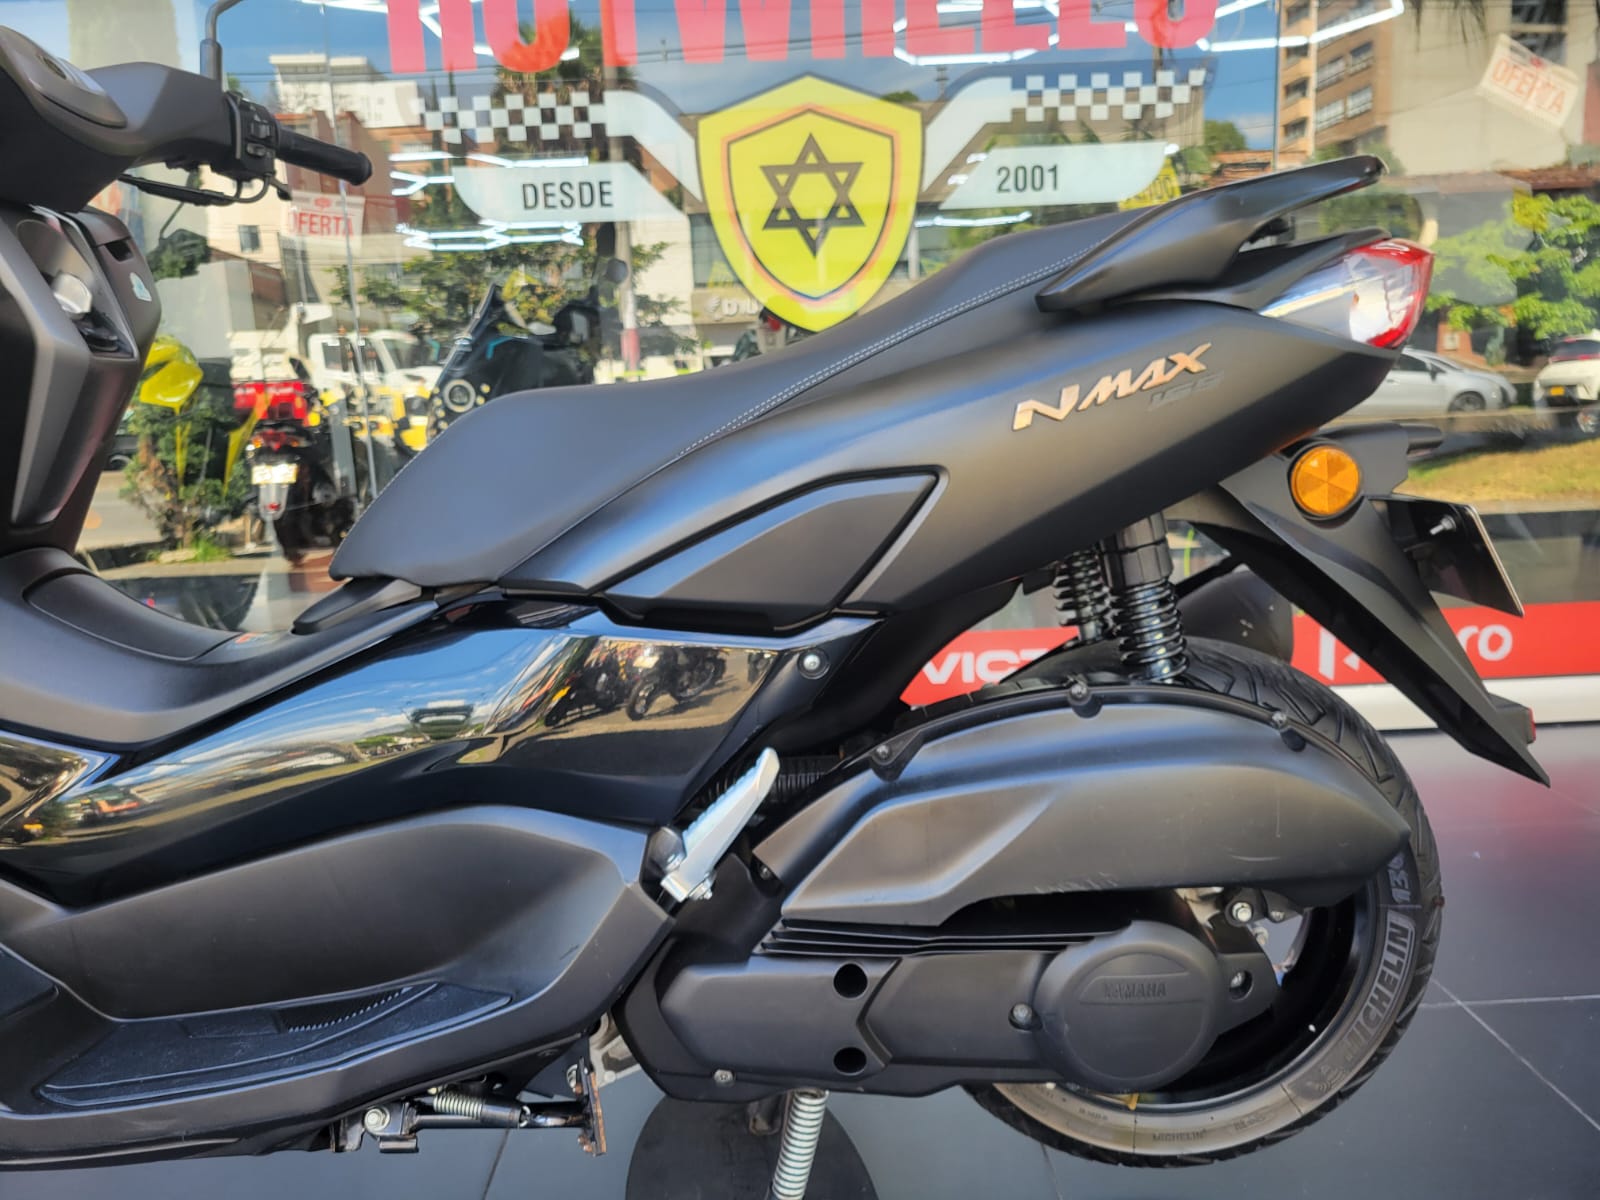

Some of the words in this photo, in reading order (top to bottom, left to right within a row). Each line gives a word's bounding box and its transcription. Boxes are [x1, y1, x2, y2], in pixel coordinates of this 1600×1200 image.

[522, 181, 613, 210] DESDE
[996, 164, 1059, 193] 2001
[1012, 342, 1212, 431] NMAX
[1345, 921, 1411, 1060] MICHELIN
